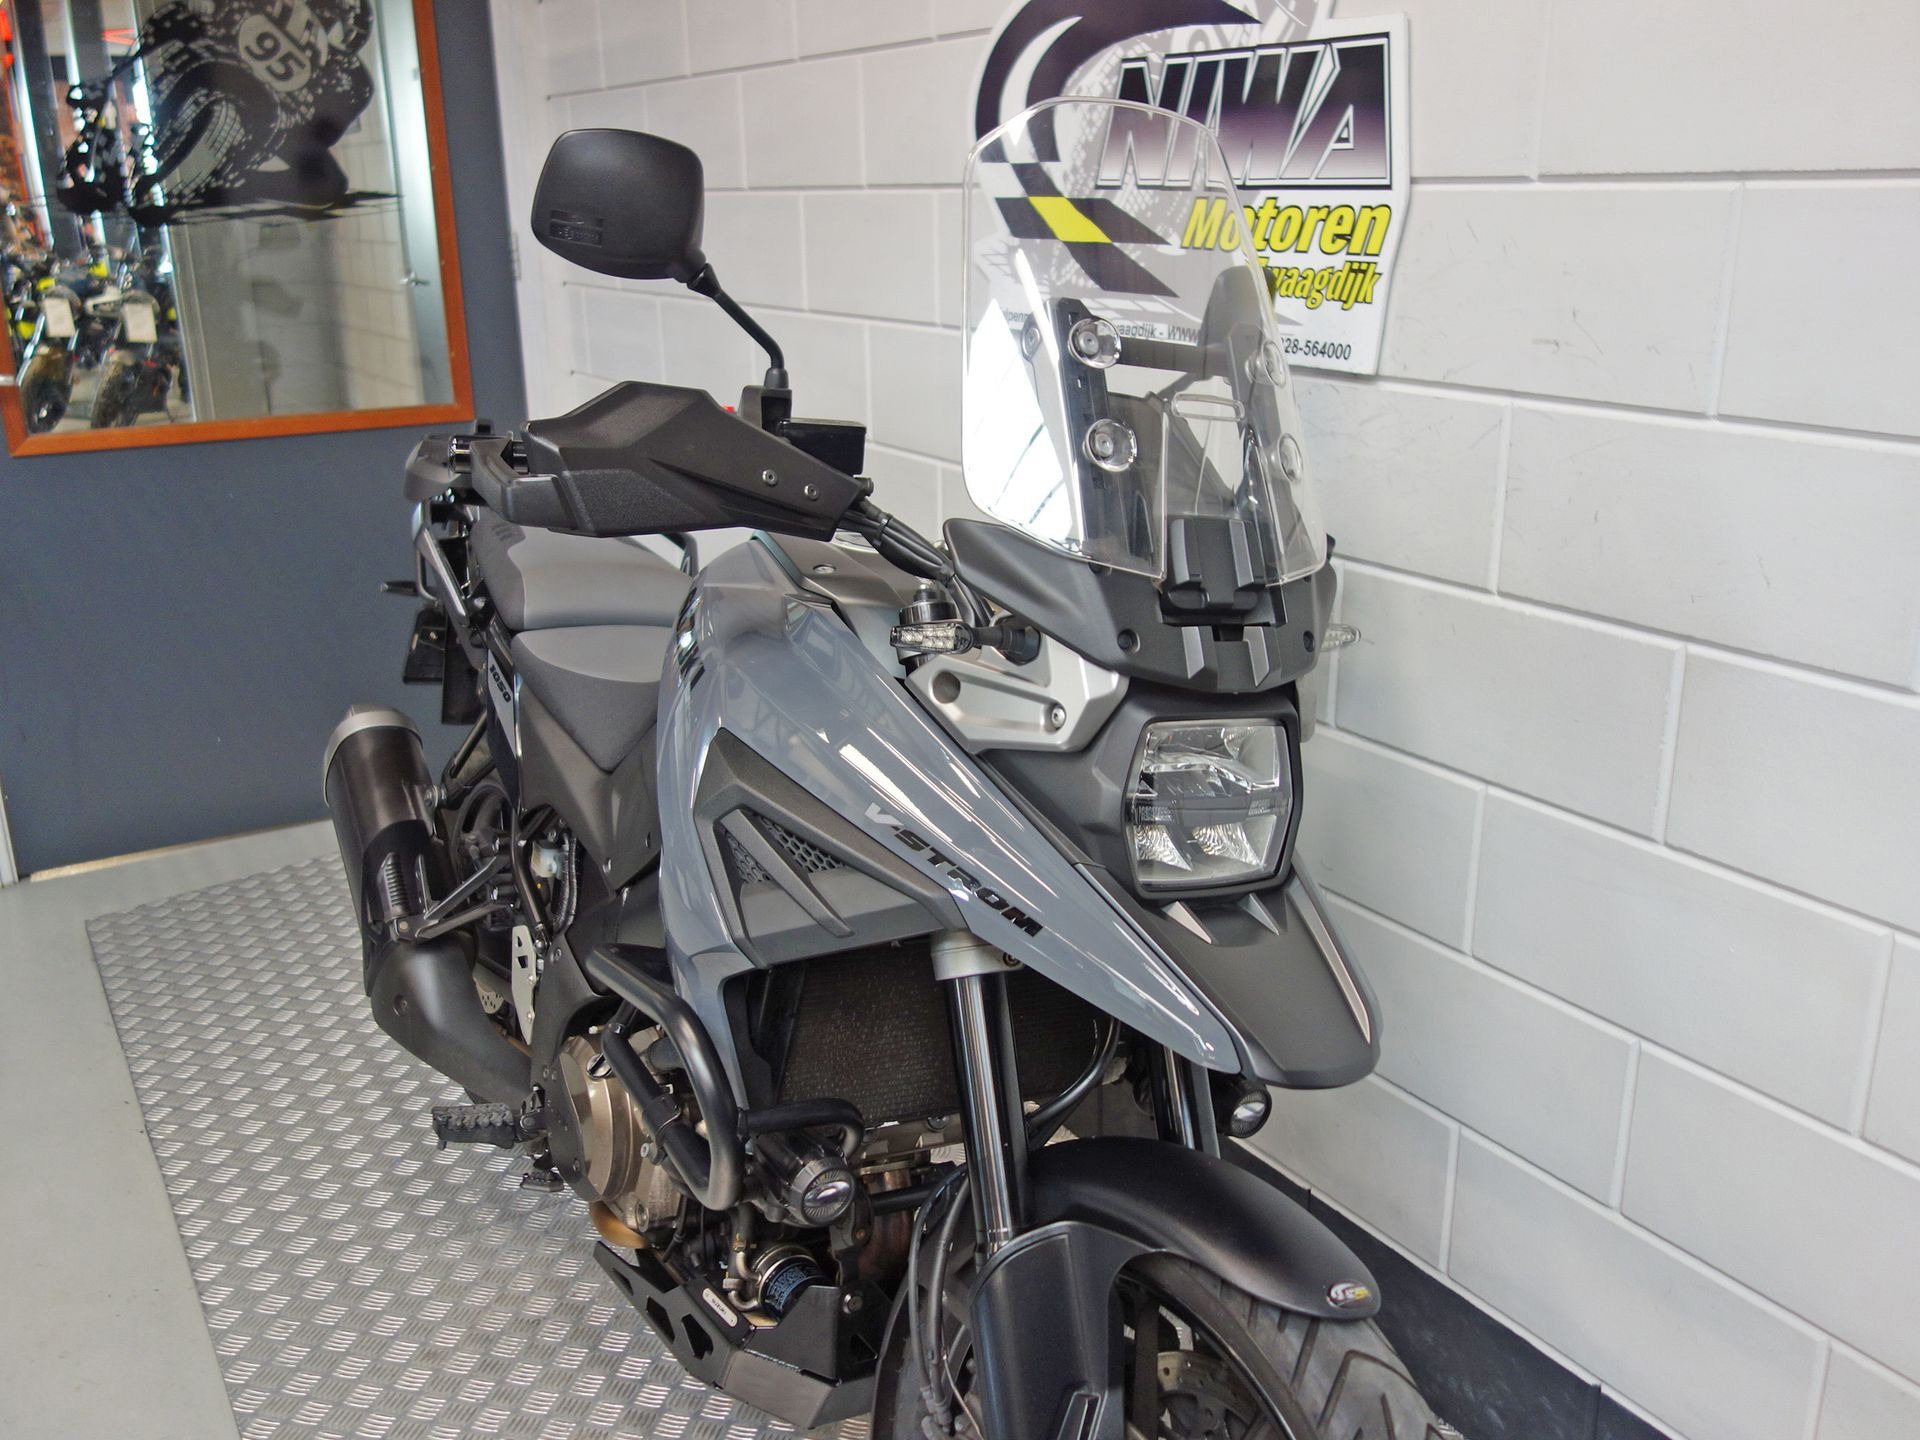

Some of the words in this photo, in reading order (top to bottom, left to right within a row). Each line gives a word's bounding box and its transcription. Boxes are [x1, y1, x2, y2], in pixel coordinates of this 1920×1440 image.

[244, 31, 306, 81] 95
[1096, 33, 1392, 189] NIWA
[1181, 196, 1392, 256] Motoren
[1257, 255, 1382, 310] waagdijk
[1280, 337, 1352, 360] 28-564000
[489, 663, 512, 703] 1050
